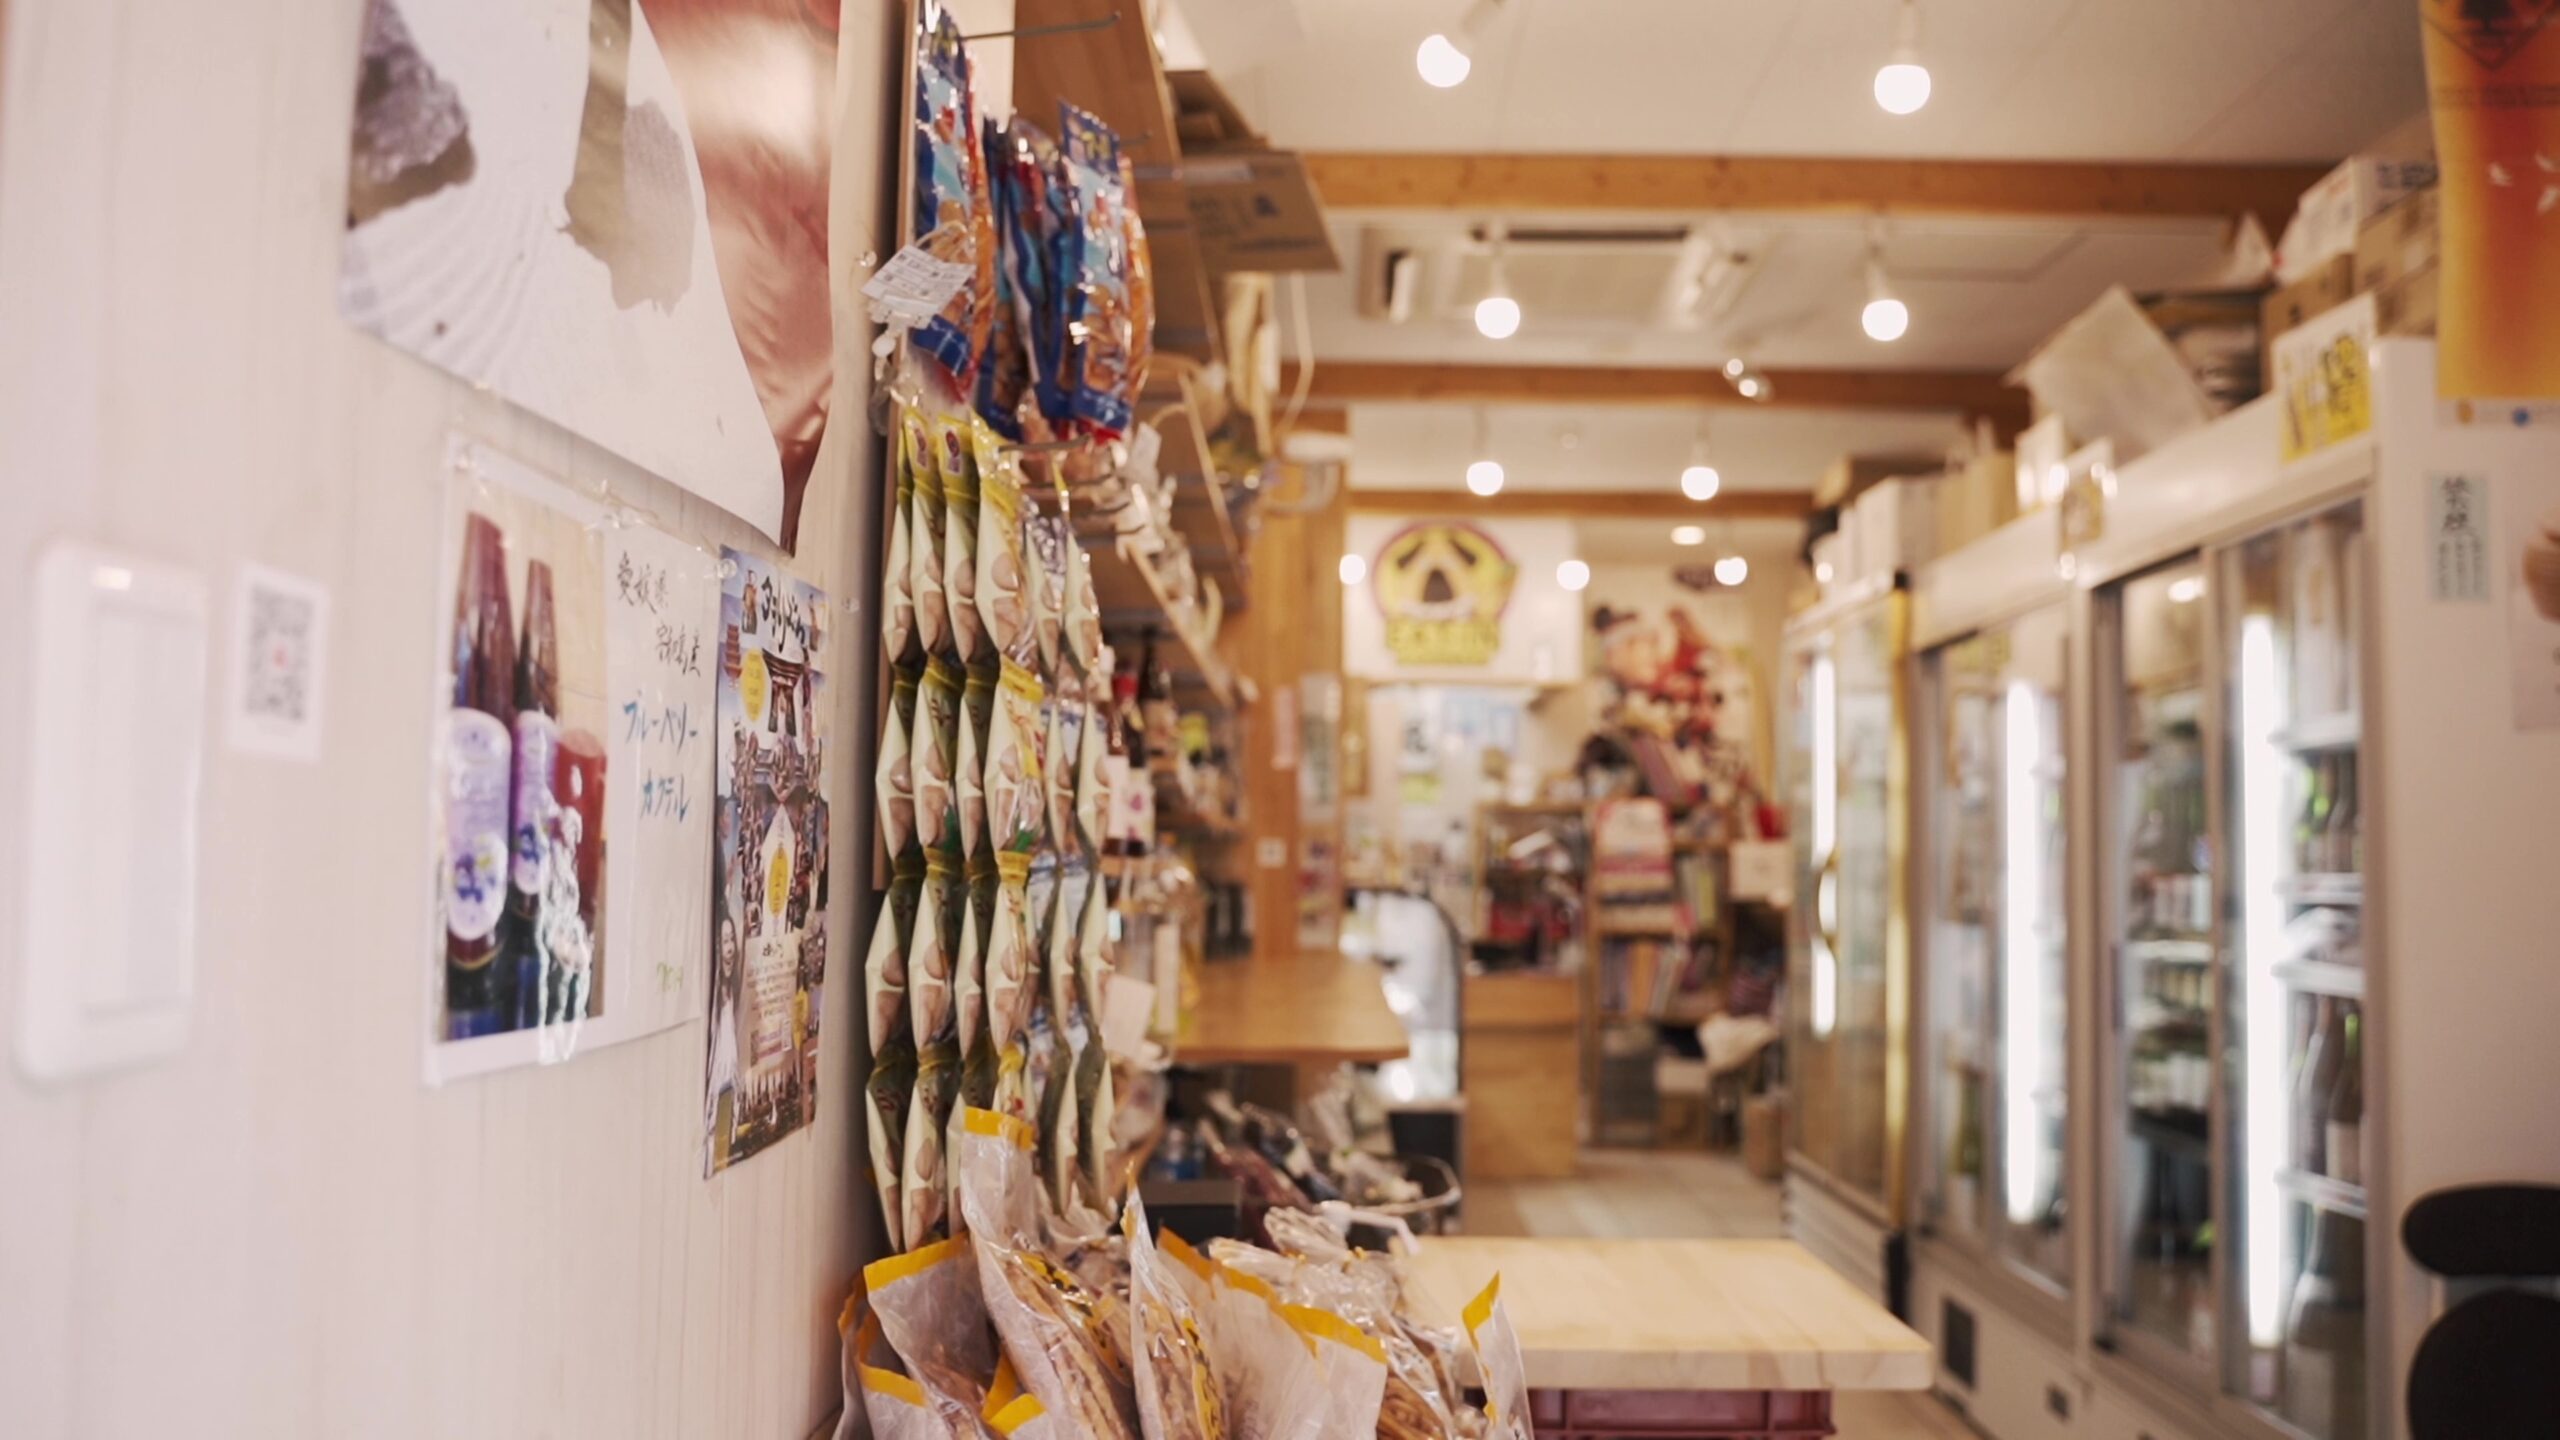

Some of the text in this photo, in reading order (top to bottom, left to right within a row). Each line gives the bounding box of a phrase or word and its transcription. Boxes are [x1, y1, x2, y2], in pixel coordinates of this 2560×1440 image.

[623, 690, 698, 756] ブルーベリー
[640, 767, 691, 824] カクテル
